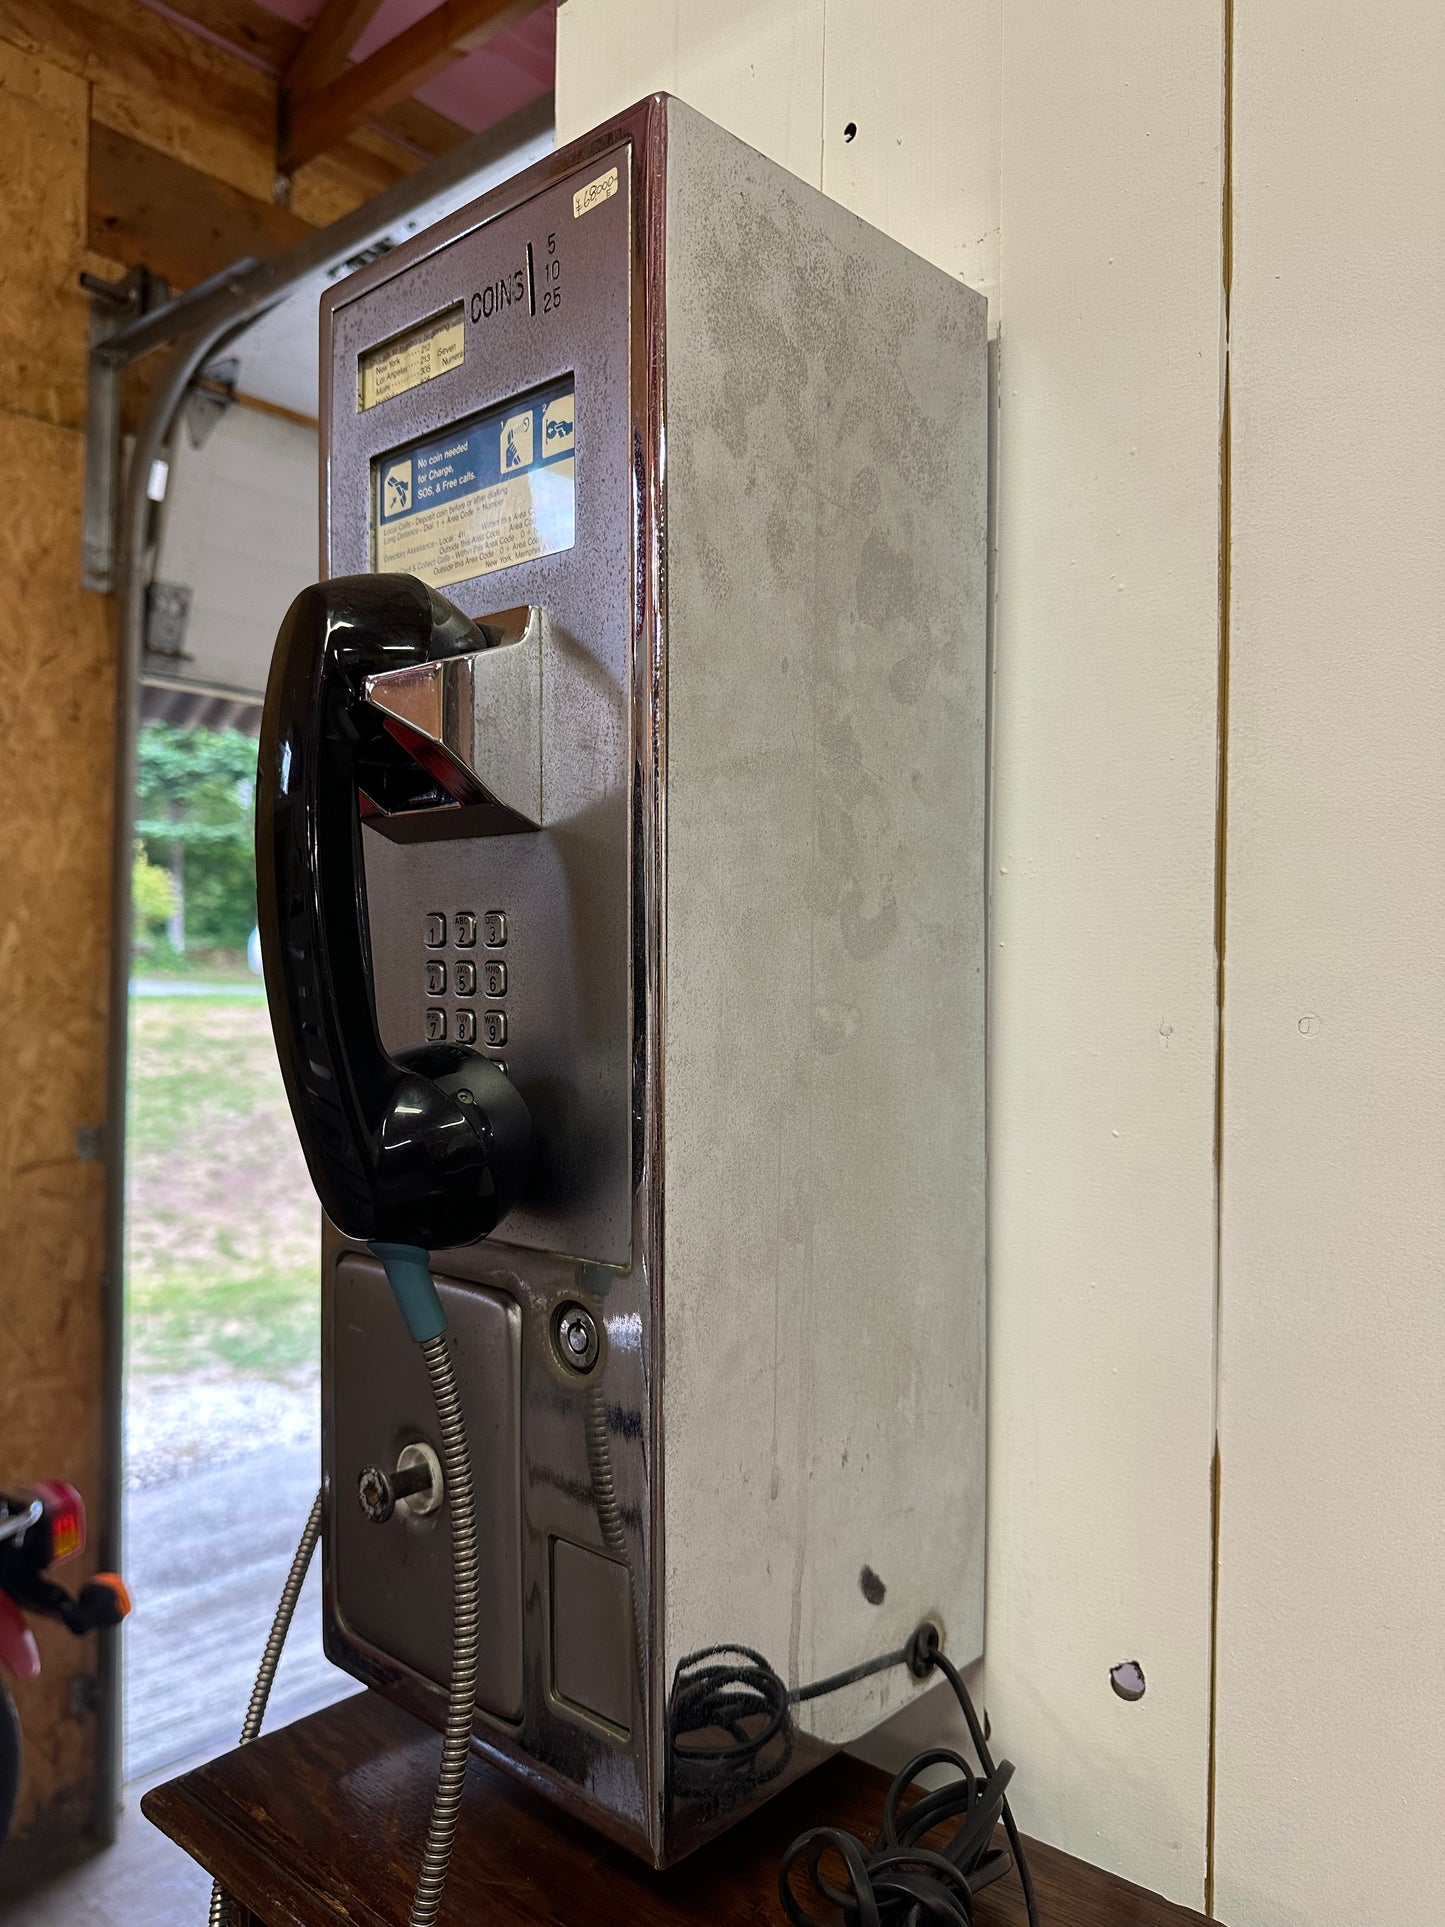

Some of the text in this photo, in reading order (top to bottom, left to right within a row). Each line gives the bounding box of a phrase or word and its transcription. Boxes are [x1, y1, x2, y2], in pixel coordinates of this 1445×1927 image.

[547, 232, 556, 255] 5
[545, 260, 560, 281] 10
[470, 270, 524, 323] COINS
[543, 286, 561, 314] 25
[376, 366, 387, 375] New
[389, 358, 400, 368] York
[542, 403, 547, 413] 2
[417, 441, 468, 469] No coin needed
[417, 471, 476, 500] SOS, & Free calls.
[418, 474, 427, 484] for
[415, 512, 435, 526] Deposit
[448, 502, 465, 514] before
[467, 500, 473, 508] or
[447, 514, 459, 524] Area
[460, 509, 474, 520] Code
[482, 499, 504, 511] Number
[439, 535, 454, 546] Local
[440, 543, 459, 555] Outside
[460, 539, 470, 547] this
[472, 533, 484, 543] Area
[486, 530, 500, 540] Code
[417, 558, 436, 570] Collect
[437, 554, 450, 565] Calls
[455, 548, 472, 559] Within
[473, 543, 483, 552] this
[485, 539, 498, 549] Area
[499, 534, 514, 545] Code
[433, 564, 453, 576] Outside
[454, 560, 464, 568] this
[465, 556, 478, 565] Area
[479, 551, 494, 561] Code
[512, 541, 526, 550] Area
[485, 559, 497, 568] New
[455, 917, 468, 925] ABC
[459, 927, 465, 943] 2
[489, 926, 495, 942] 3
[456, 965, 468, 974] JKL
[429, 975, 435, 991] 4
[459, 976, 465, 991] 5
[490, 976, 496, 992] 6
[430, 1022, 436, 1037] 7
[459, 1023, 465, 1039] 8
[490, 1025, 495, 1041] 9
